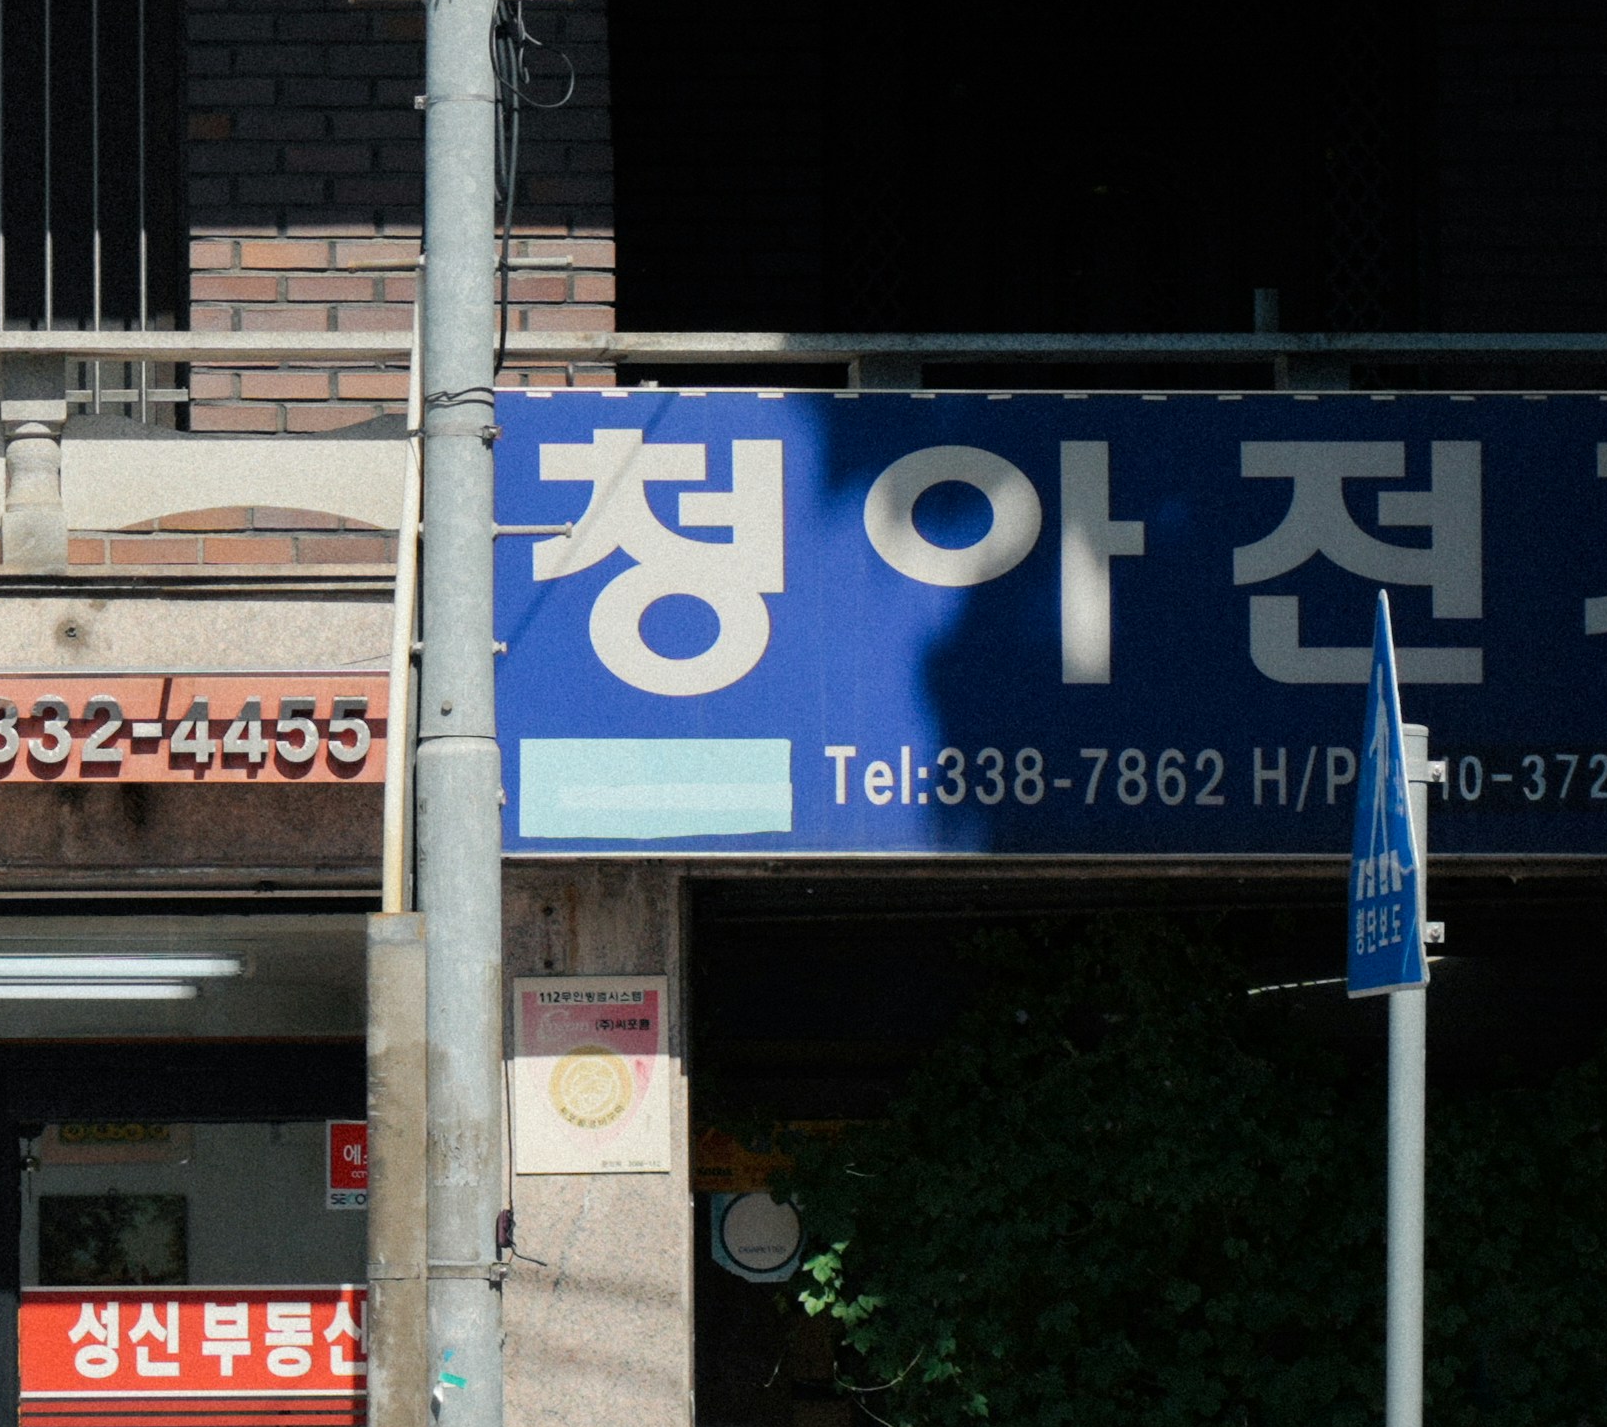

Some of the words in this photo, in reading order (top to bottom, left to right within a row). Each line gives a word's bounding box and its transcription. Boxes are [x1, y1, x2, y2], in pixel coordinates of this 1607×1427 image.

[824, 743, 1228, 812] Tel:338-7862
[1355, 905, 1403, 955] 횡단보도
[331, 1193, 368, 1206] SECO
